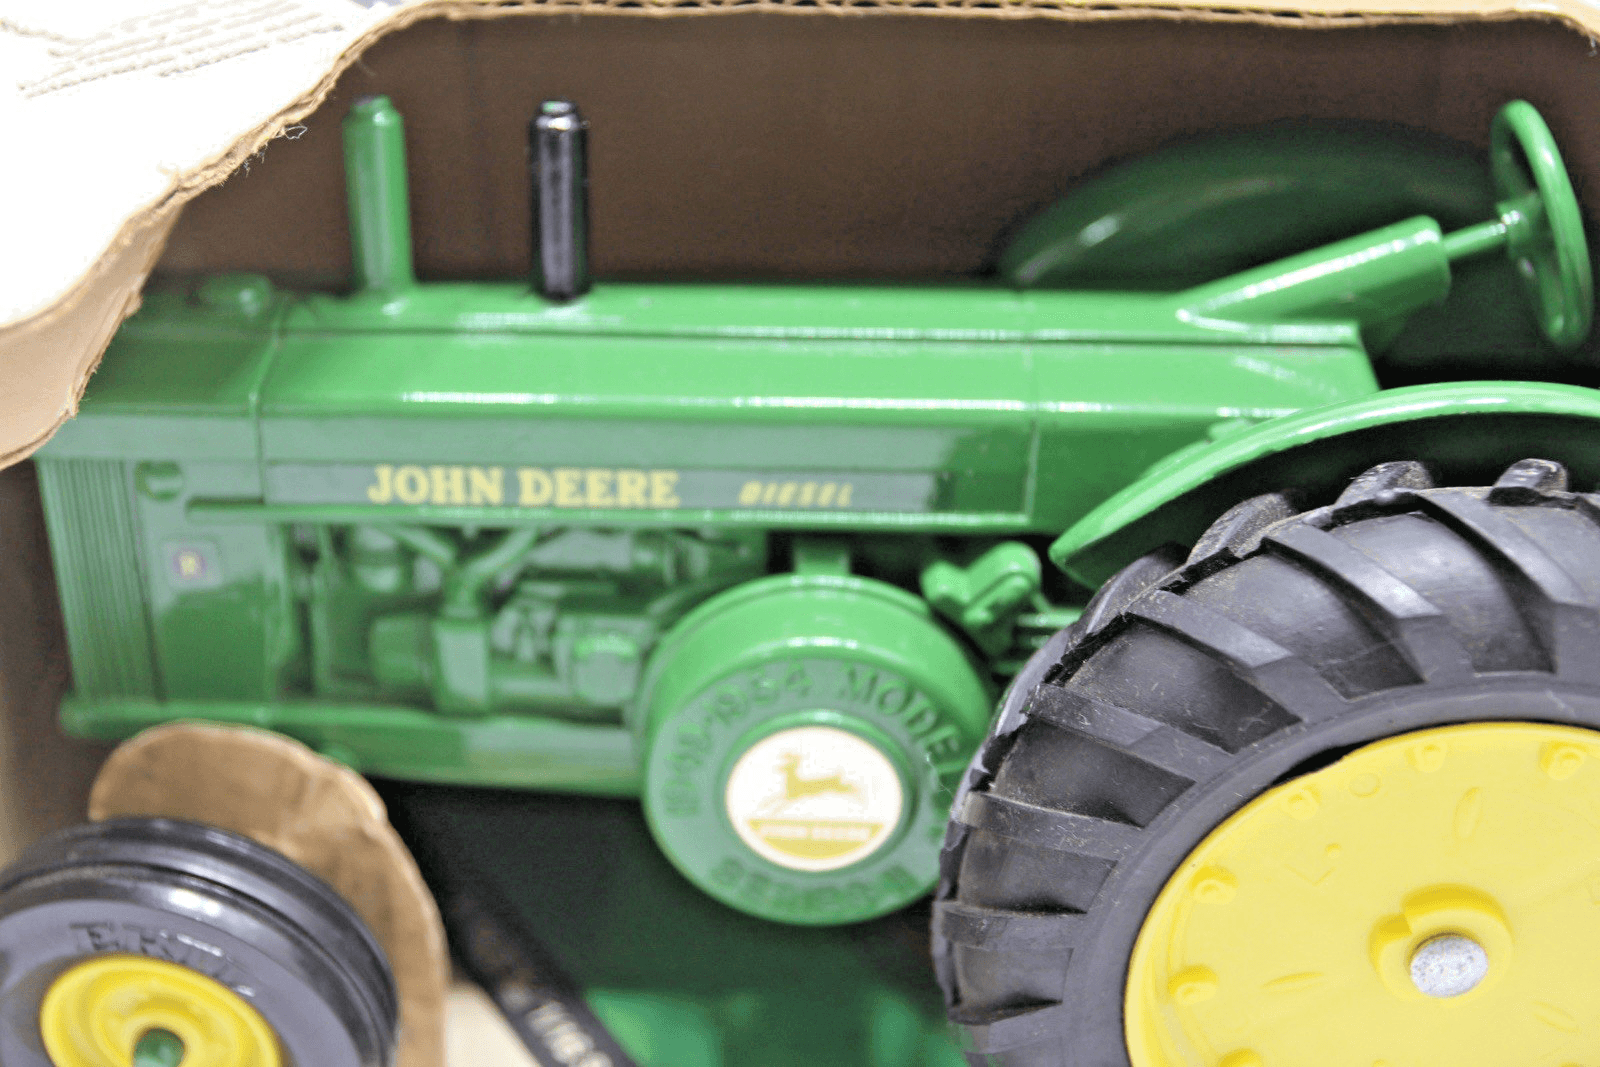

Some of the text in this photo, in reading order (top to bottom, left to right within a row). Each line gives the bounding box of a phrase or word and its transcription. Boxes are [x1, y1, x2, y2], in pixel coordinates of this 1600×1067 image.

[367, 464, 505, 505] JOHN
[516, 467, 680, 508] DEERE
[838, 657, 970, 790] MODEL
